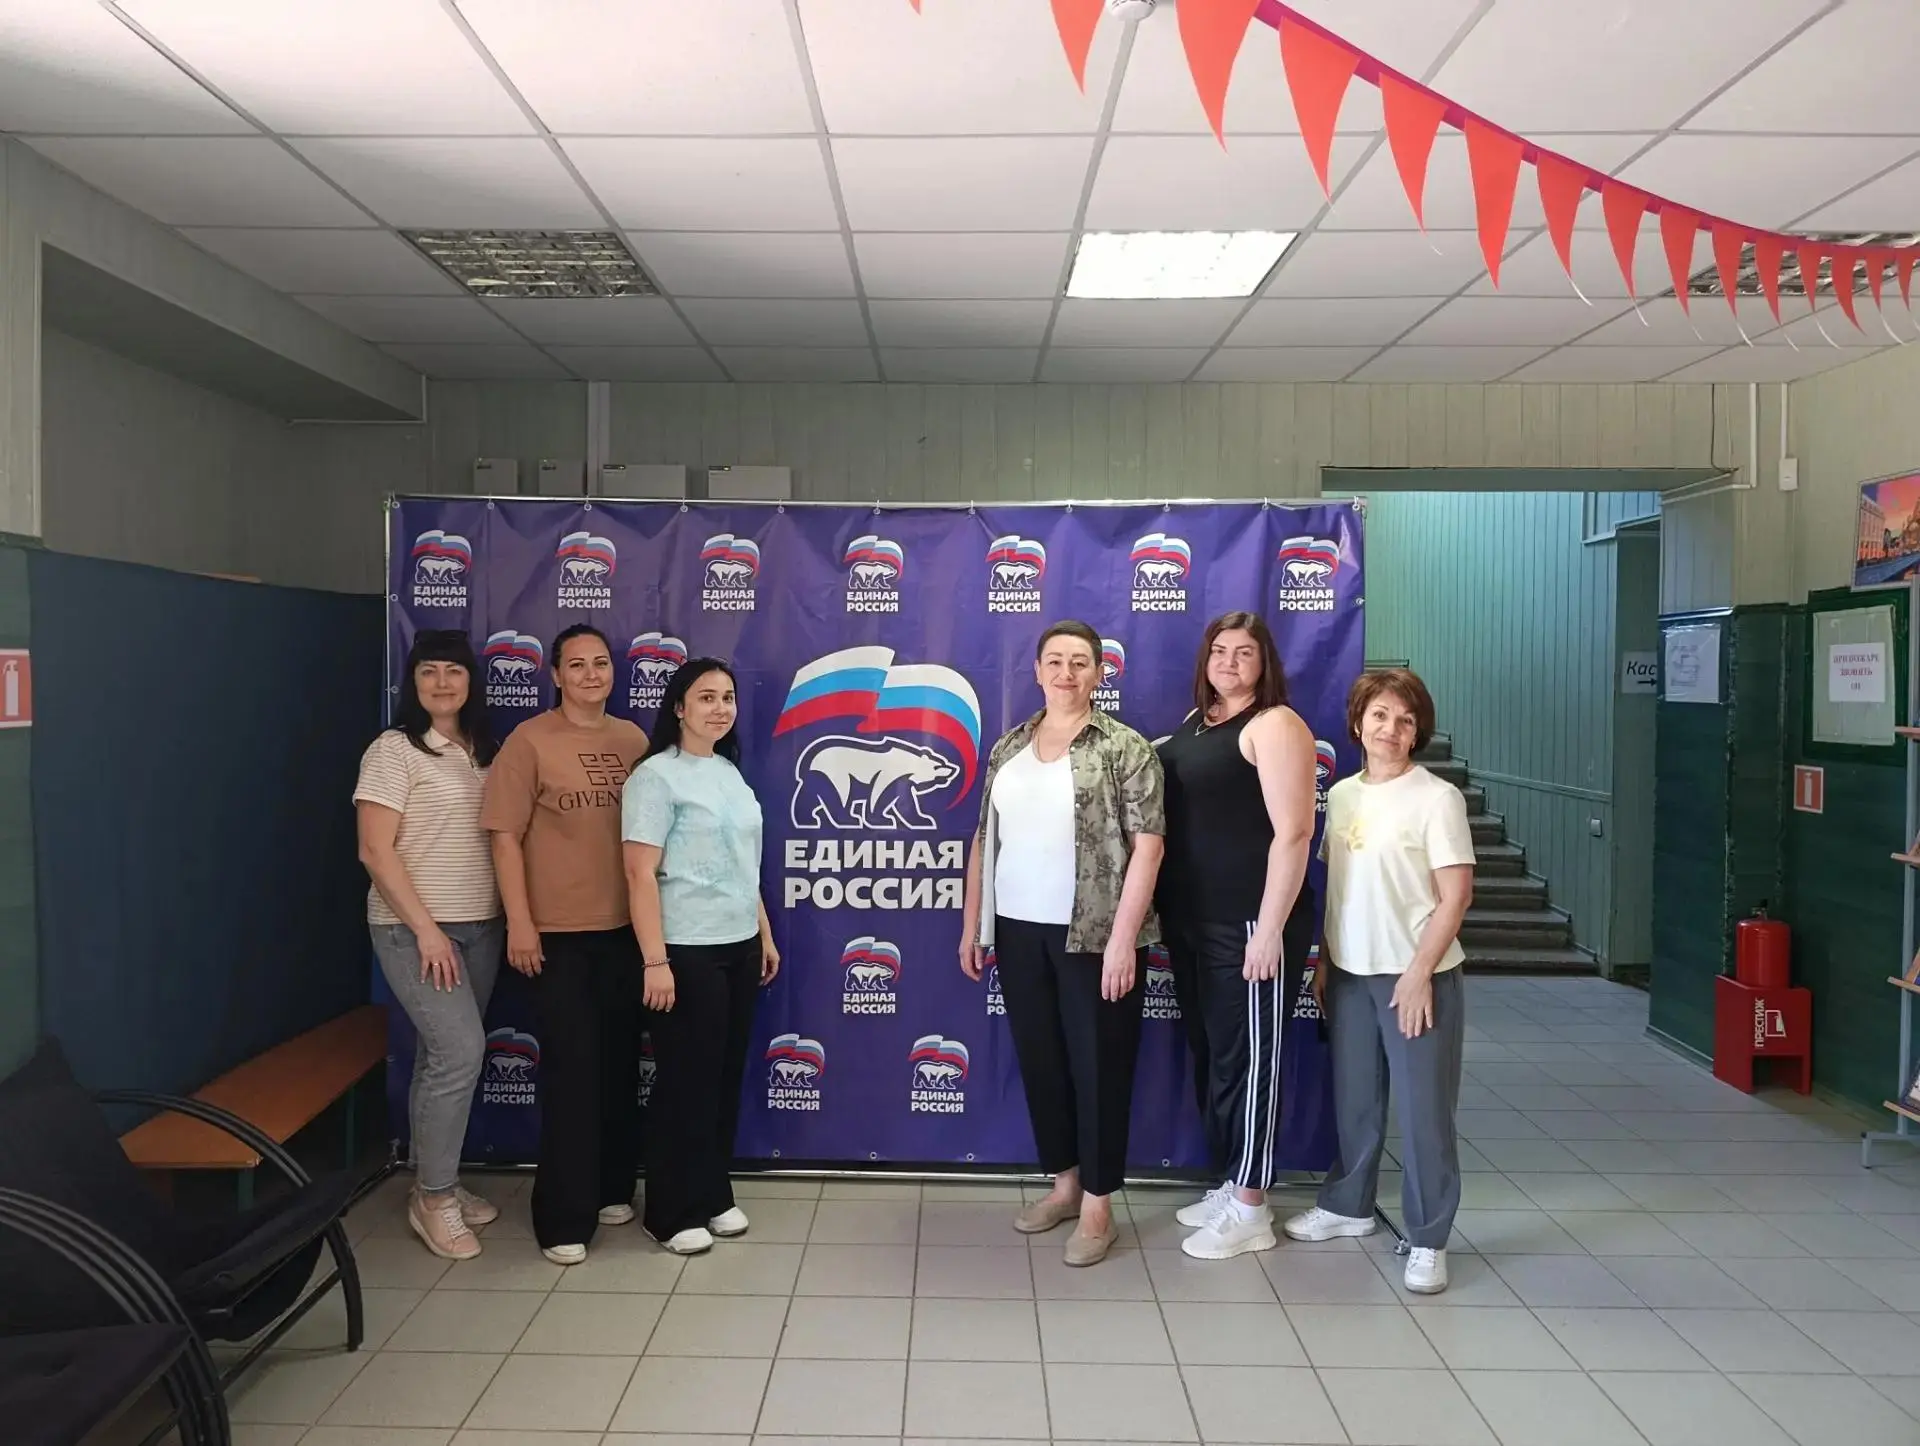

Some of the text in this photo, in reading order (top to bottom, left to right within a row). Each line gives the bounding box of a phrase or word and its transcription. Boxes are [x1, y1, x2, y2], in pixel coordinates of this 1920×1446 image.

[414, 586, 466, 596] ЕДИНАЯ
[558, 588, 610, 598] ЕДИНАЯ
[703, 590, 754, 599] ЕДИНАЯ
[1132, 590, 1185, 601] ЕДИНАЯ
[1280, 589, 1333, 600] ЕДИНАЯ
[414, 597, 466, 606] РОССИЯ
[847, 592, 898, 601] ЕДИНАЯ
[989, 592, 1040, 602] ЕДИНАЯ
[558, 599, 610, 608] РОССИЯ
[703, 601, 754, 610] РОССИЯ
[847, 603, 898, 611] РОССИЯ
[989, 603, 1040, 612] РОССИЯ
[1132, 601, 1185, 610] РОССИЯ
[1280, 600, 1333, 610] РОССИЯ
[1627, 661, 1657, 675] Кас
[487, 686, 538, 696] ЕДИНАЯ
[630, 688, 665, 698] ЕДИН
[487, 697, 537, 706] РОССИЯ
[630, 699, 661, 708] РОСС
[558, 790, 620, 811] GIVEN
[785, 840, 964, 872] ЕДИНАЯ
[784, 877, 964, 909] РОССИЯ
[844, 993, 895, 1003] ЕДИНАЯ
[844, 1004, 895, 1013] РОССИЯ
[1142, 1007, 1181, 1019] ОССИ
[1754, 997, 1765, 1048] ПРЕСТИЖ
[484, 1083, 535, 1094] ЕДИНАЯ
[484, 1094, 535, 1104] РОССИЯ
[768, 1089, 819, 1099] ЕДИНАЯ
[912, 1091, 963, 1102] ЕДИНАЯ
[768, 1100, 819, 1110] РОССИЯ
[912, 1102, 963, 1112] РОССИЯ
